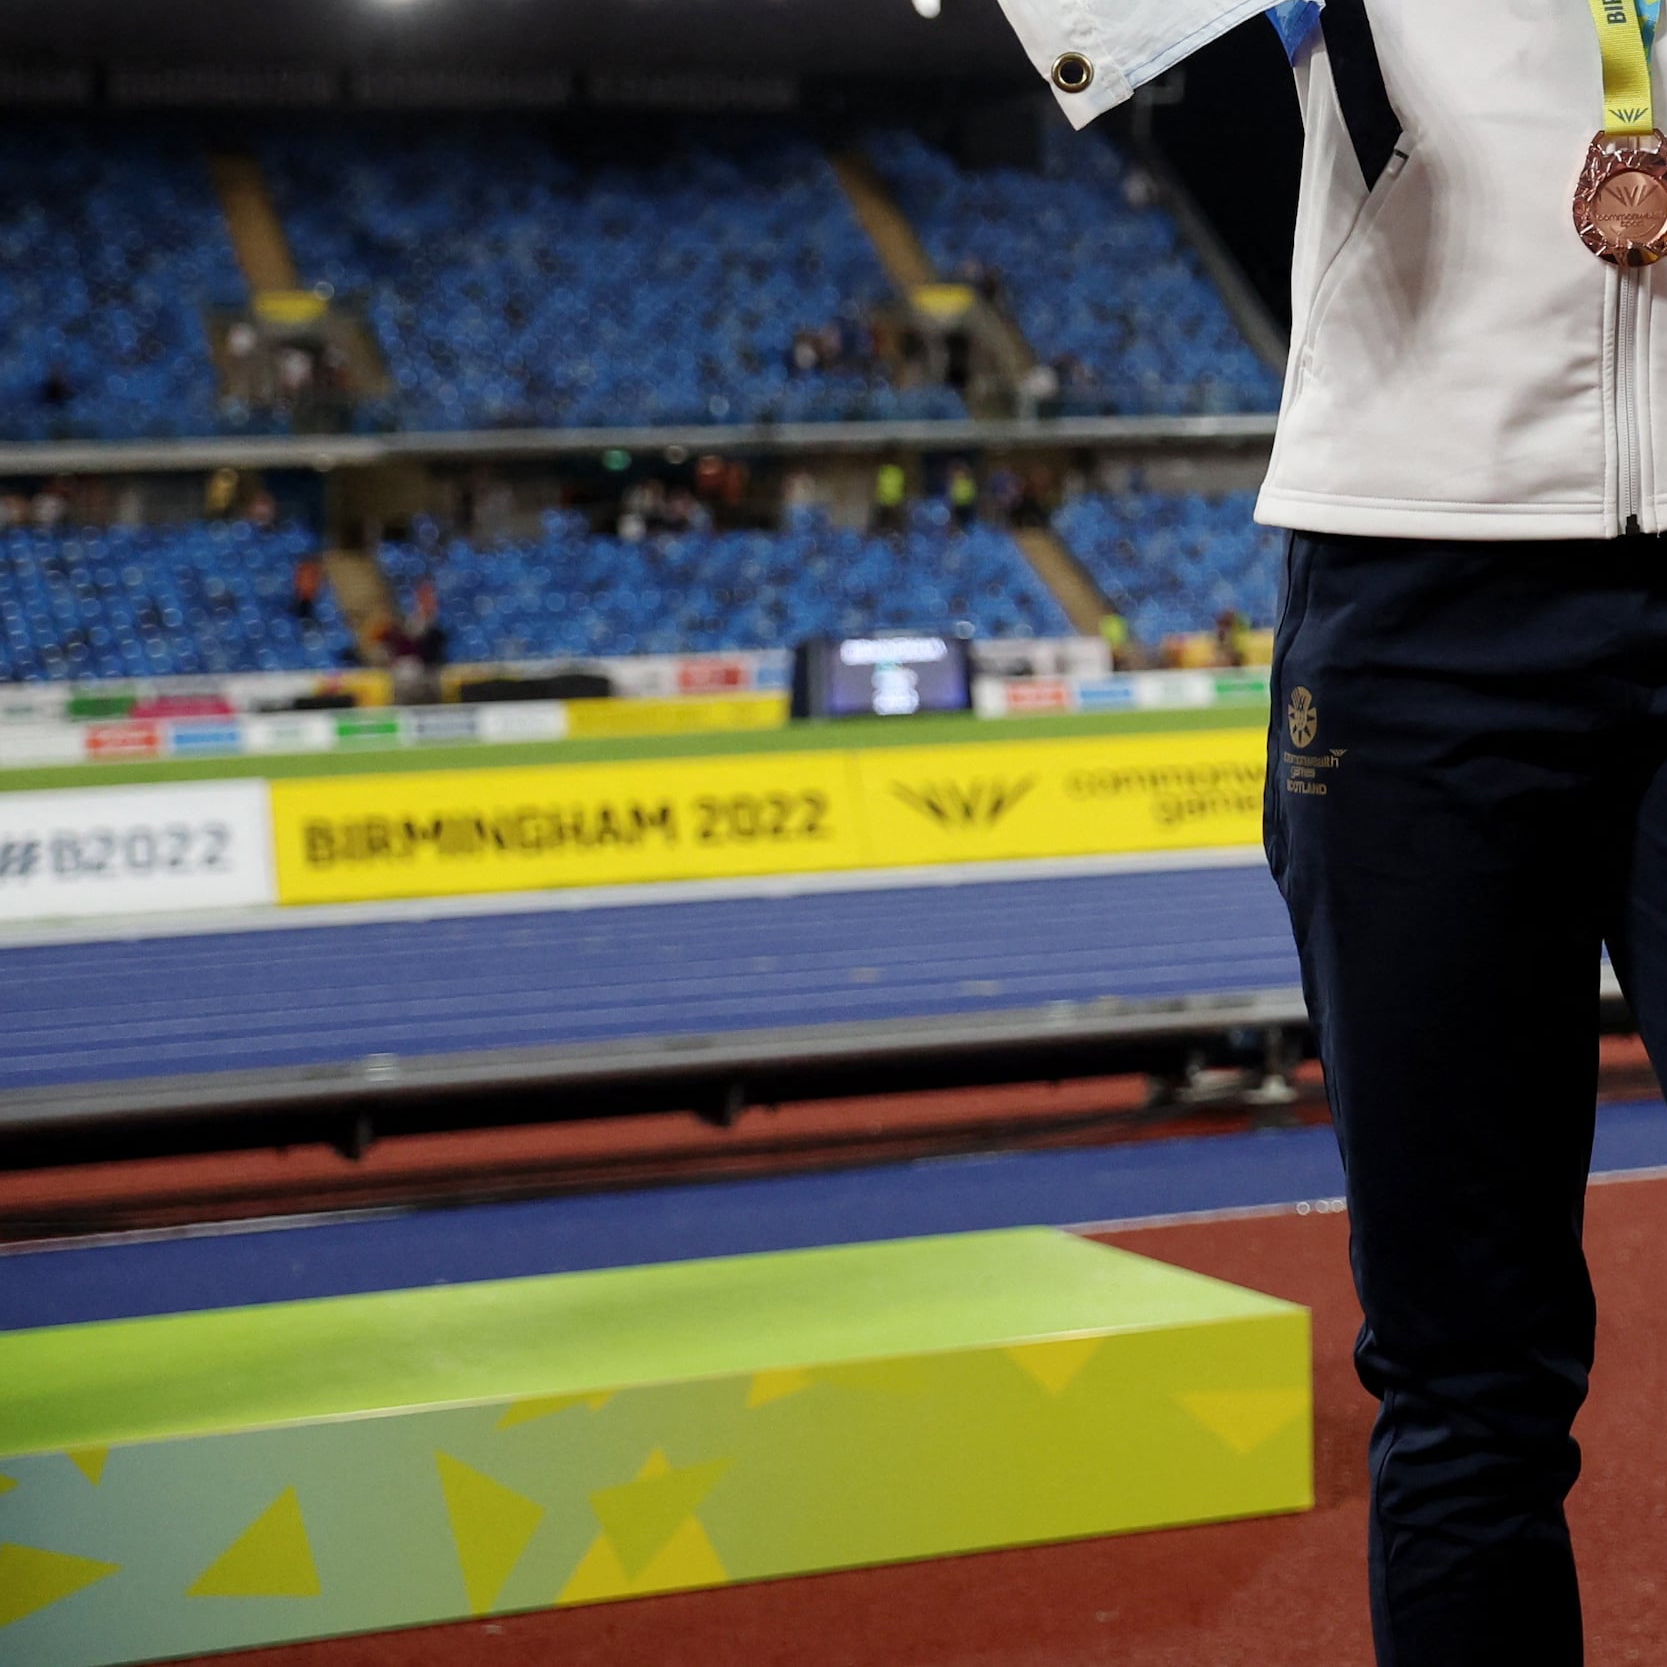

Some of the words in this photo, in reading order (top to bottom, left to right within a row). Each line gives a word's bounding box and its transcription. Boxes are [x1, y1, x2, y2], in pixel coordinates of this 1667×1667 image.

[0, 820, 231, 879] #B2022
[305, 798, 676, 866] BIRMINGHAM
[695, 791, 828, 845] 2022
